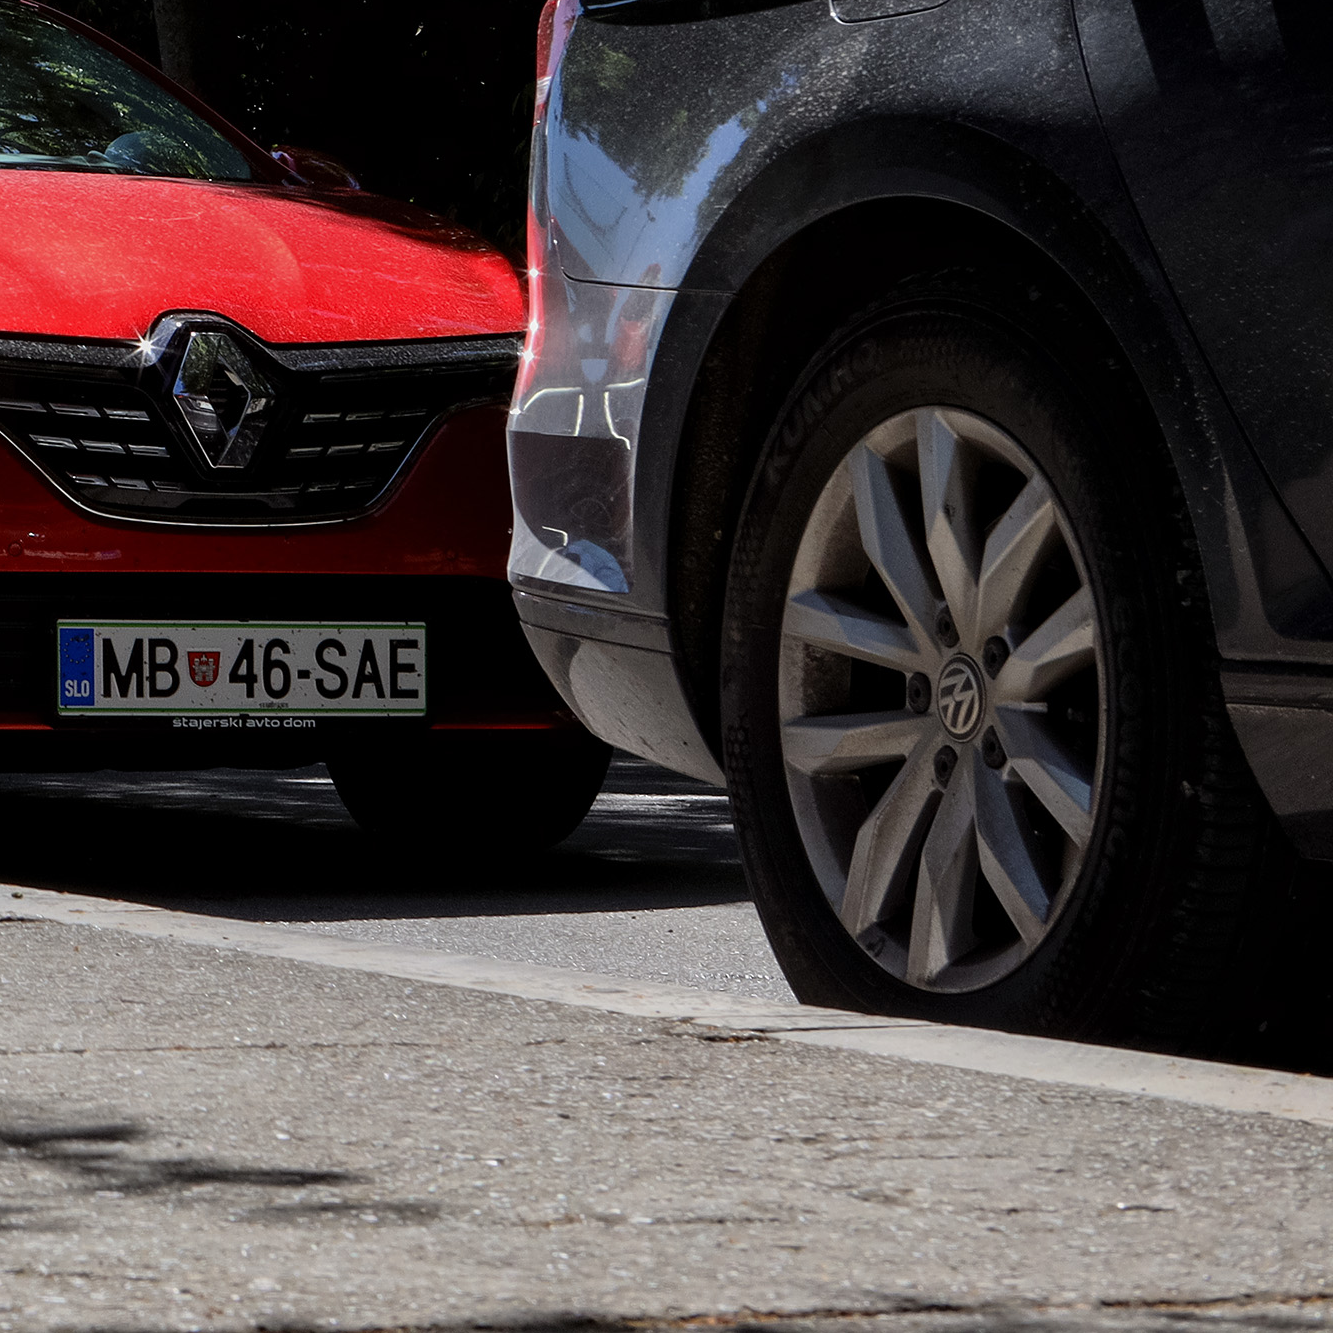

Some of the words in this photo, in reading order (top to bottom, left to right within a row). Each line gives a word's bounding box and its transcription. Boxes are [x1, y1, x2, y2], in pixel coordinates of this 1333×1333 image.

[101, 638, 180, 699] MB
[228, 638, 420, 699] 46-SAE
[64, 679, 90, 698] SLO
[245, 717, 281, 728] avto
[282, 717, 317, 728] dom
